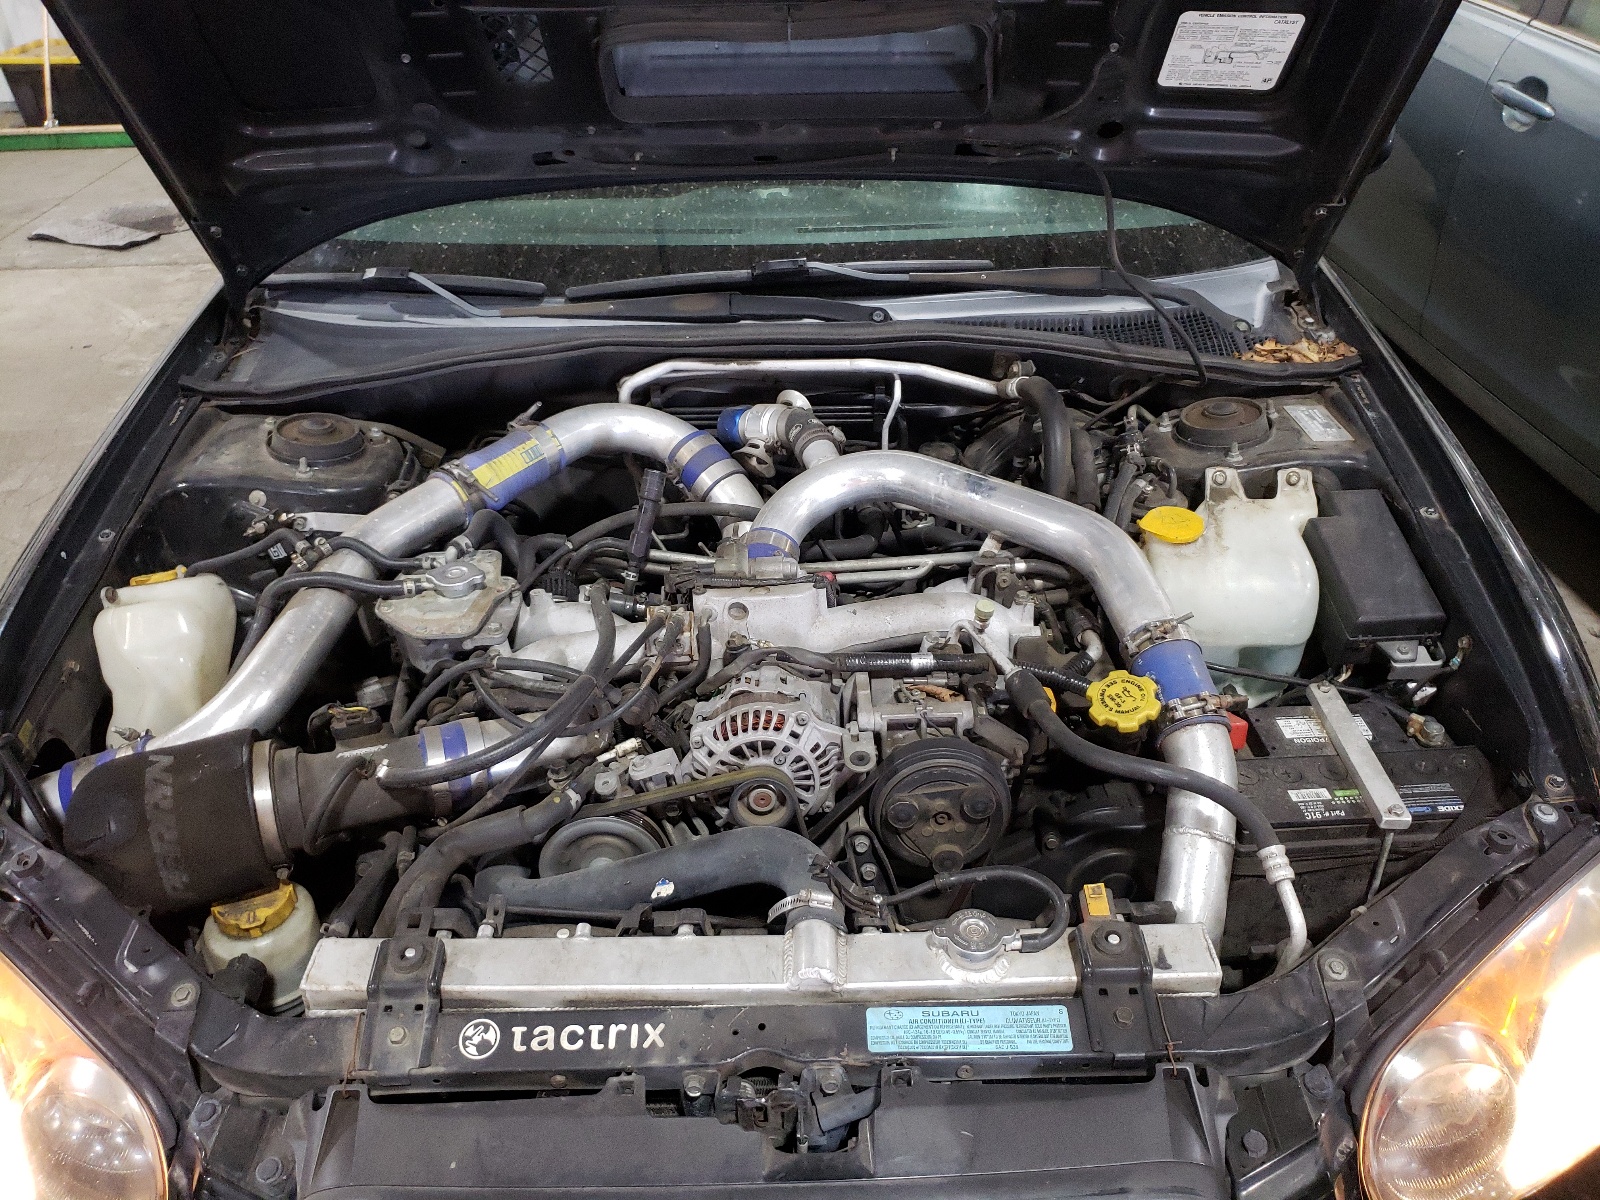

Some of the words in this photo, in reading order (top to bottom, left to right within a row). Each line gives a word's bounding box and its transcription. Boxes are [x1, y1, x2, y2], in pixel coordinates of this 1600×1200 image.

[1121, 679, 1145, 692] ENGINE
[1105, 680, 1118, 688] SEE
[1115, 705, 1141, 714] MANUAL
[1305, 812, 1322, 820] 91C
[511, 1022, 666, 1052] tactrix
